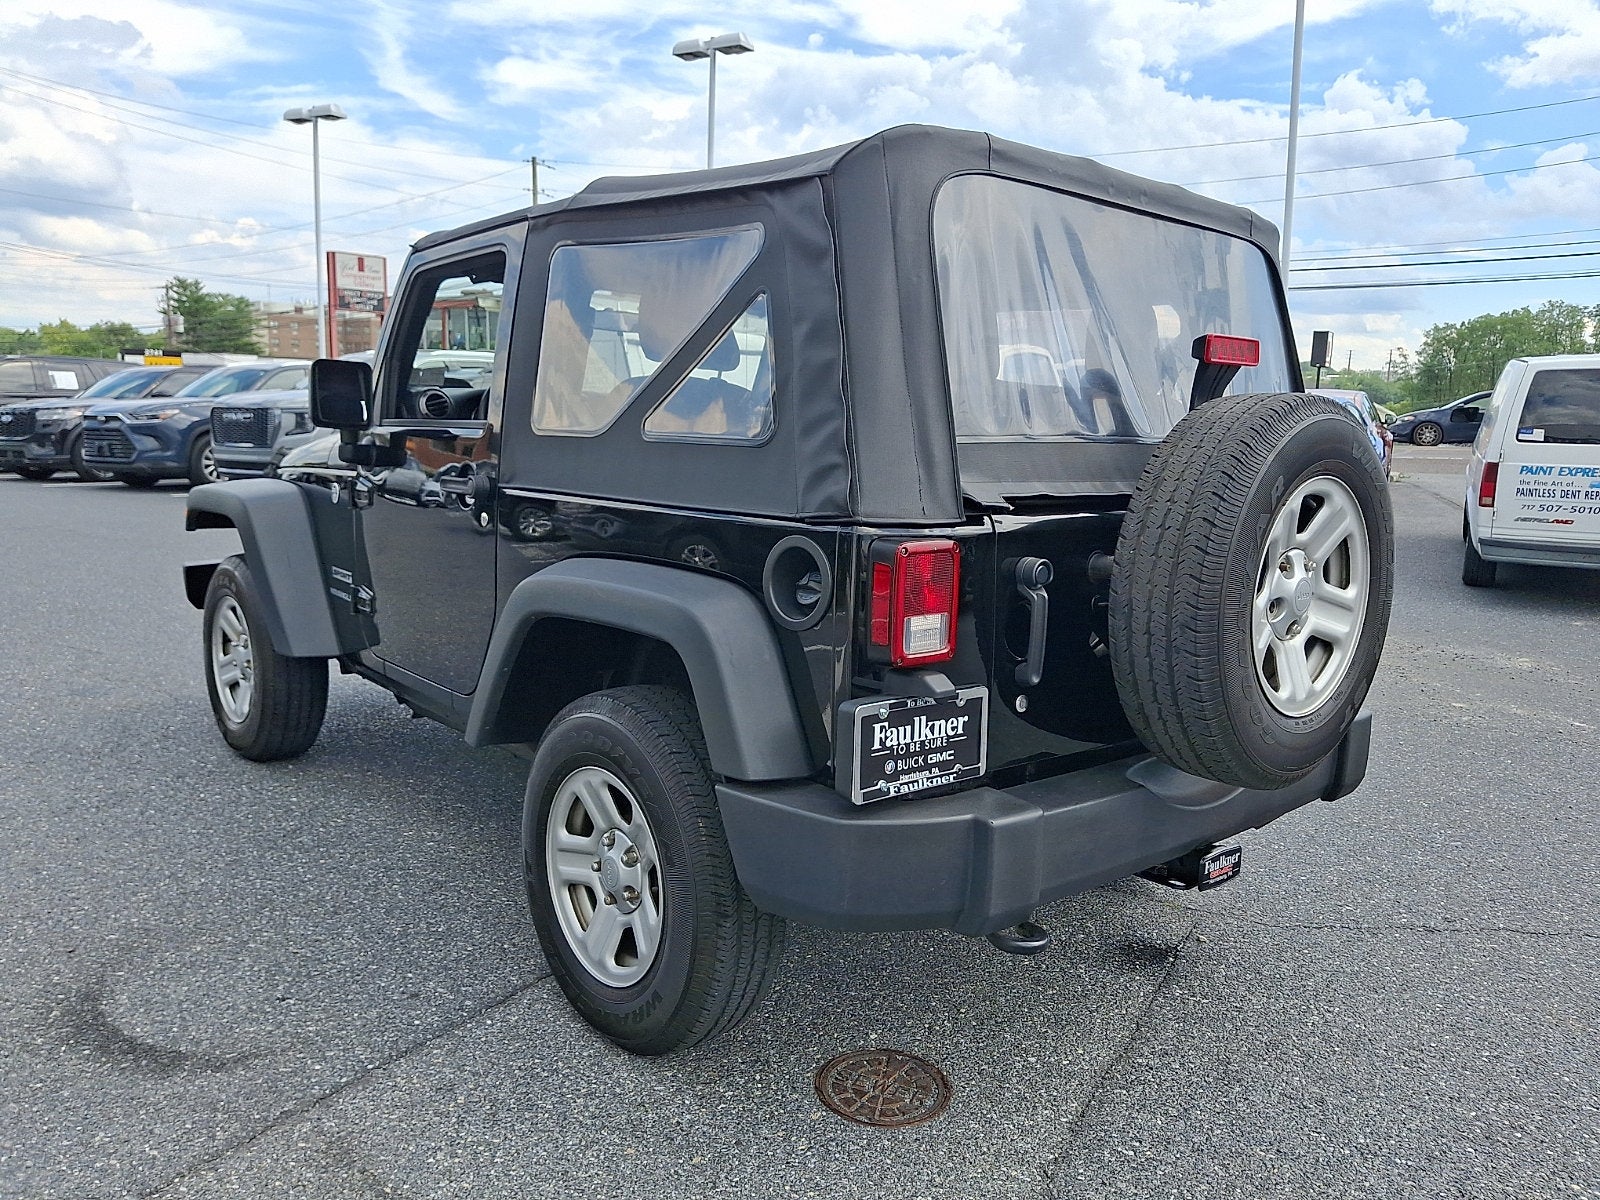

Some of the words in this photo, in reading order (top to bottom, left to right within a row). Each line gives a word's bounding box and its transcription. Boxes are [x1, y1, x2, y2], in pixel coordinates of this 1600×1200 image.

[1519, 465, 1555, 476] PAINT
[1557, 466, 1600, 478] EXPRE
[1533, 479, 1548, 487] Fine
[1515, 487, 1556, 498] PAINTLESS
[1560, 489, 1581, 500] DENT
[1584, 490, 1600, 501] REP
[1537, 504, 1600, 515] 507-5010
[871, 715, 969, 750] Faulkner
[893, 745, 907, 755] TO
[909, 741, 921, 753] BE
[925, 737, 948, 750] SURE
[897, 755, 925, 771] BUICK
[928, 750, 955, 764] GMC
[931, 766, 940, 775] PA
[888, 773, 957, 796] Faulkner
[1204, 852, 1241, 875] Faulkner
